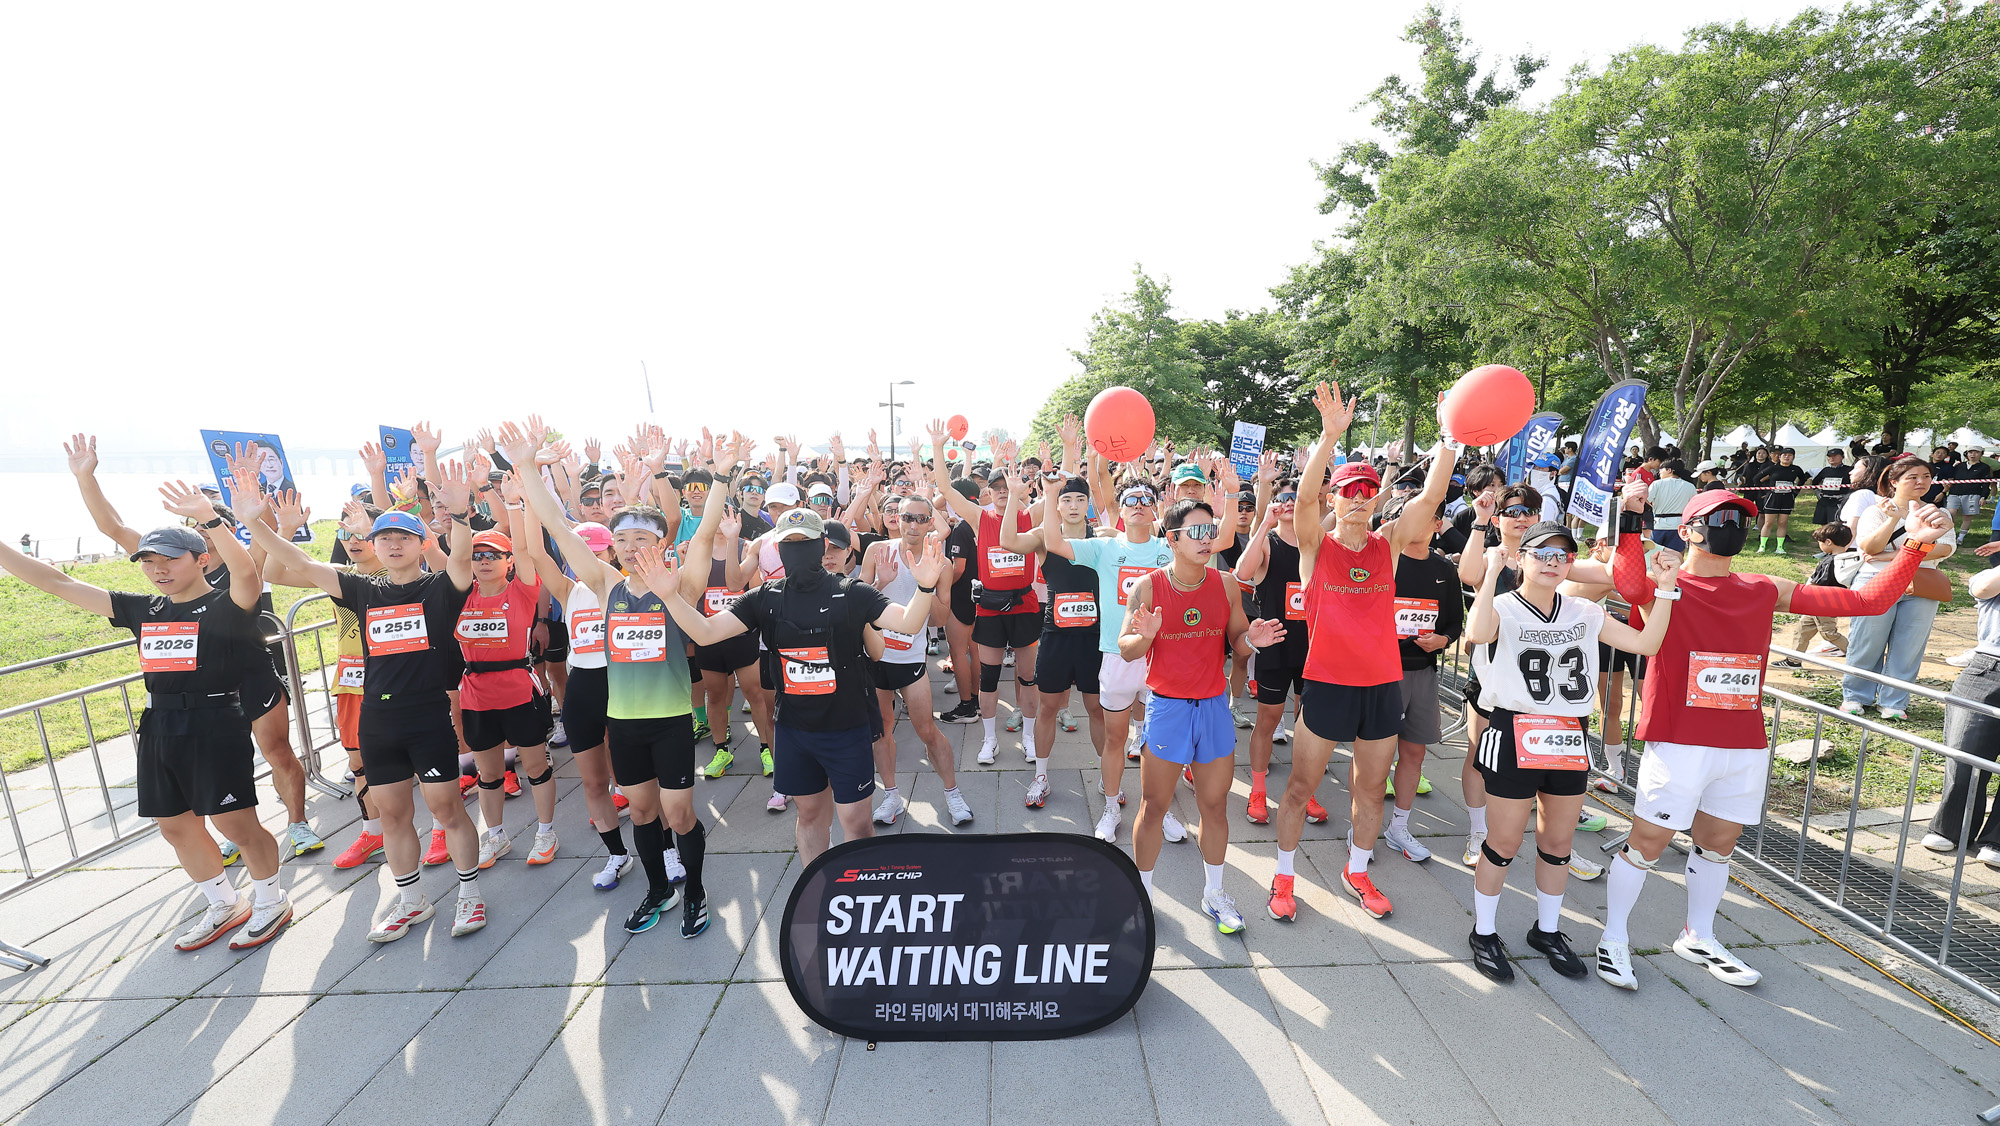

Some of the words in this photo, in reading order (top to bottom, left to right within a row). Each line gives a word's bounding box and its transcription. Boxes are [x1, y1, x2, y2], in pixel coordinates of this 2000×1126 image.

[1232, 435, 1263, 453] 정근식
[1596, 397, 1637, 485] 정근식
[1575, 480, 1606, 506] 민주진보
[1572, 491, 1603, 518] 단일후보
[1002, 555, 1024, 563] 1592
[1071, 604, 1095, 612] 1893
[1410, 612, 1437, 622] 2457
[384, 619, 421, 634] 2551
[472, 622, 506, 632] 3802
[1518, 622, 1587, 646] LEGEND
[616, 632, 624, 640] M
[626, 629, 663, 640] 2489
[1160, 630, 1205, 642] Kwanghwamun
[154, 639, 194, 650] 2026
[789, 666, 797, 674] M
[1517, 645, 1595, 706] 83
[1704, 674, 1718, 683] M
[1720, 672, 1757, 686] 2461
[1529, 736, 1540, 744] W
[1543, 734, 1582, 746] 4356
[835, 868, 894, 883] SMART
[896, 872, 923, 880] CHIP
[826, 893, 965, 935] START
[827, 944, 1002, 987] WAITING
[1014, 943, 1111, 984] LINE
[875, 1003, 907, 1022] 라인
[910, 1002, 958, 1022] 뒤에서
[963, 1001, 1060, 1022] 대기해주세요
